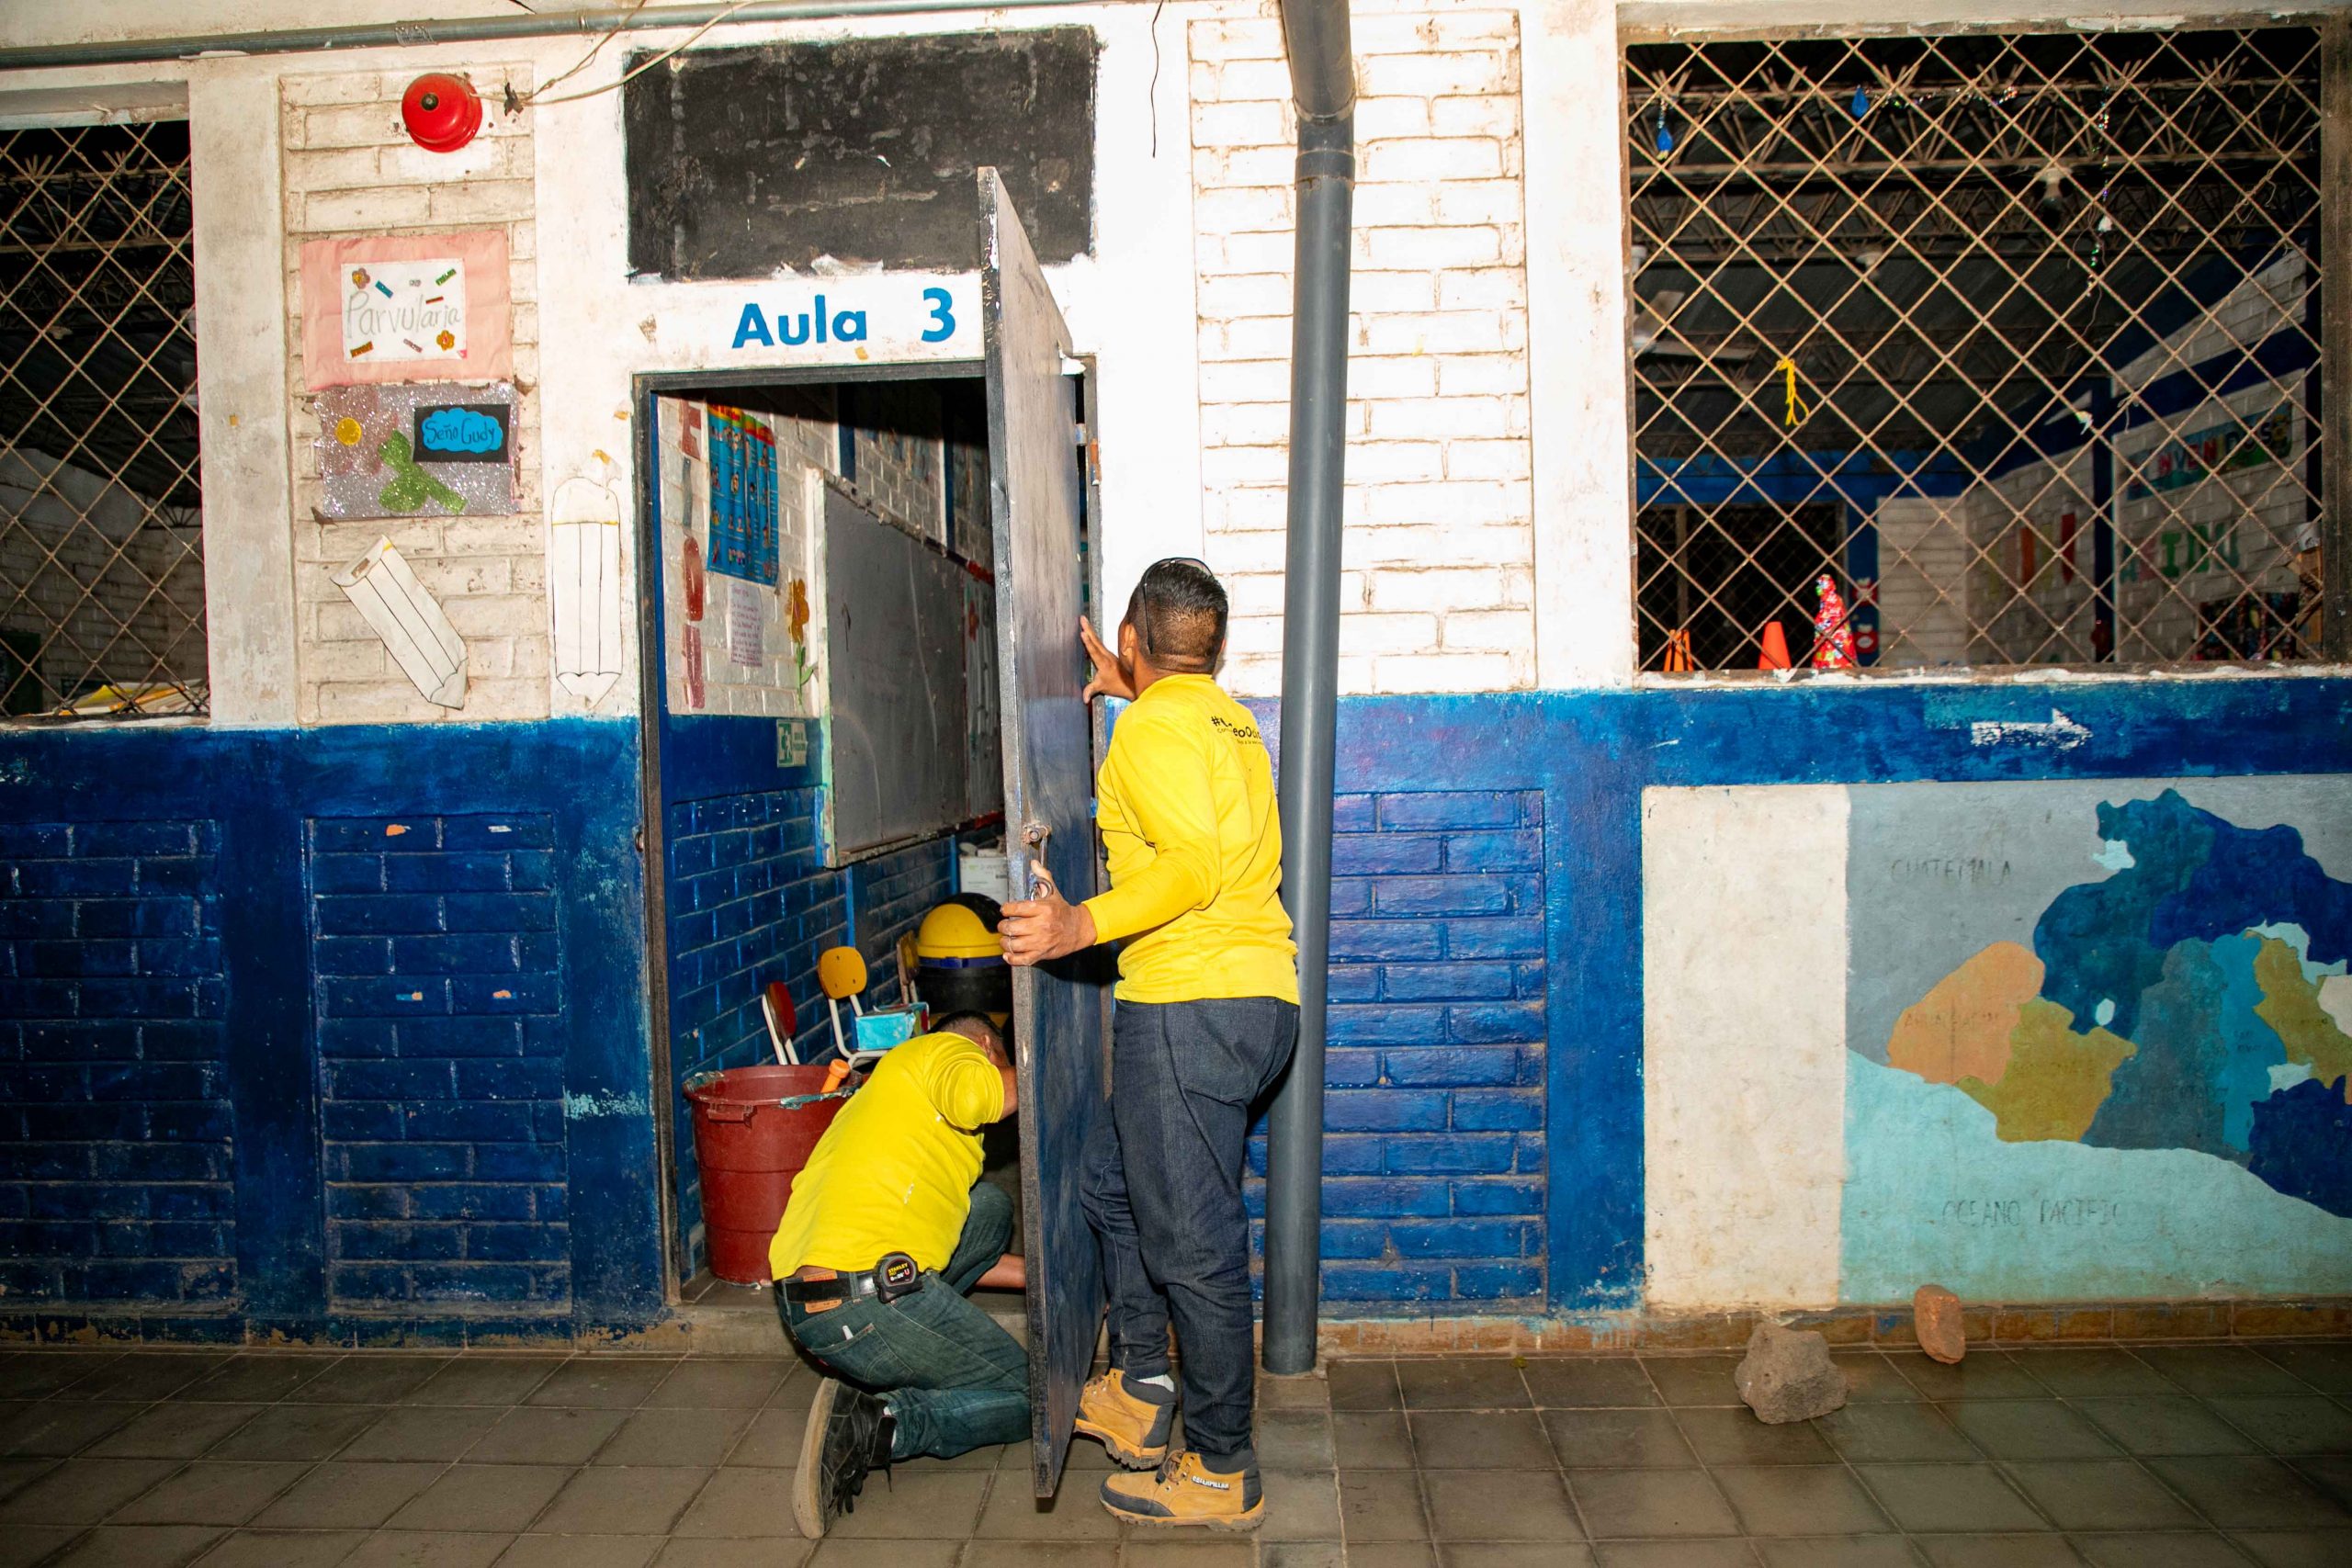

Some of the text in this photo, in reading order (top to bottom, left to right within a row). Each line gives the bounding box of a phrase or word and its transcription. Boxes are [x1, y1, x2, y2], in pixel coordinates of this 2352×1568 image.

[345, 289, 460, 339] Parvularia
[732, 287, 956, 349] Aula 3
[425, 420, 458, 445] Seño
